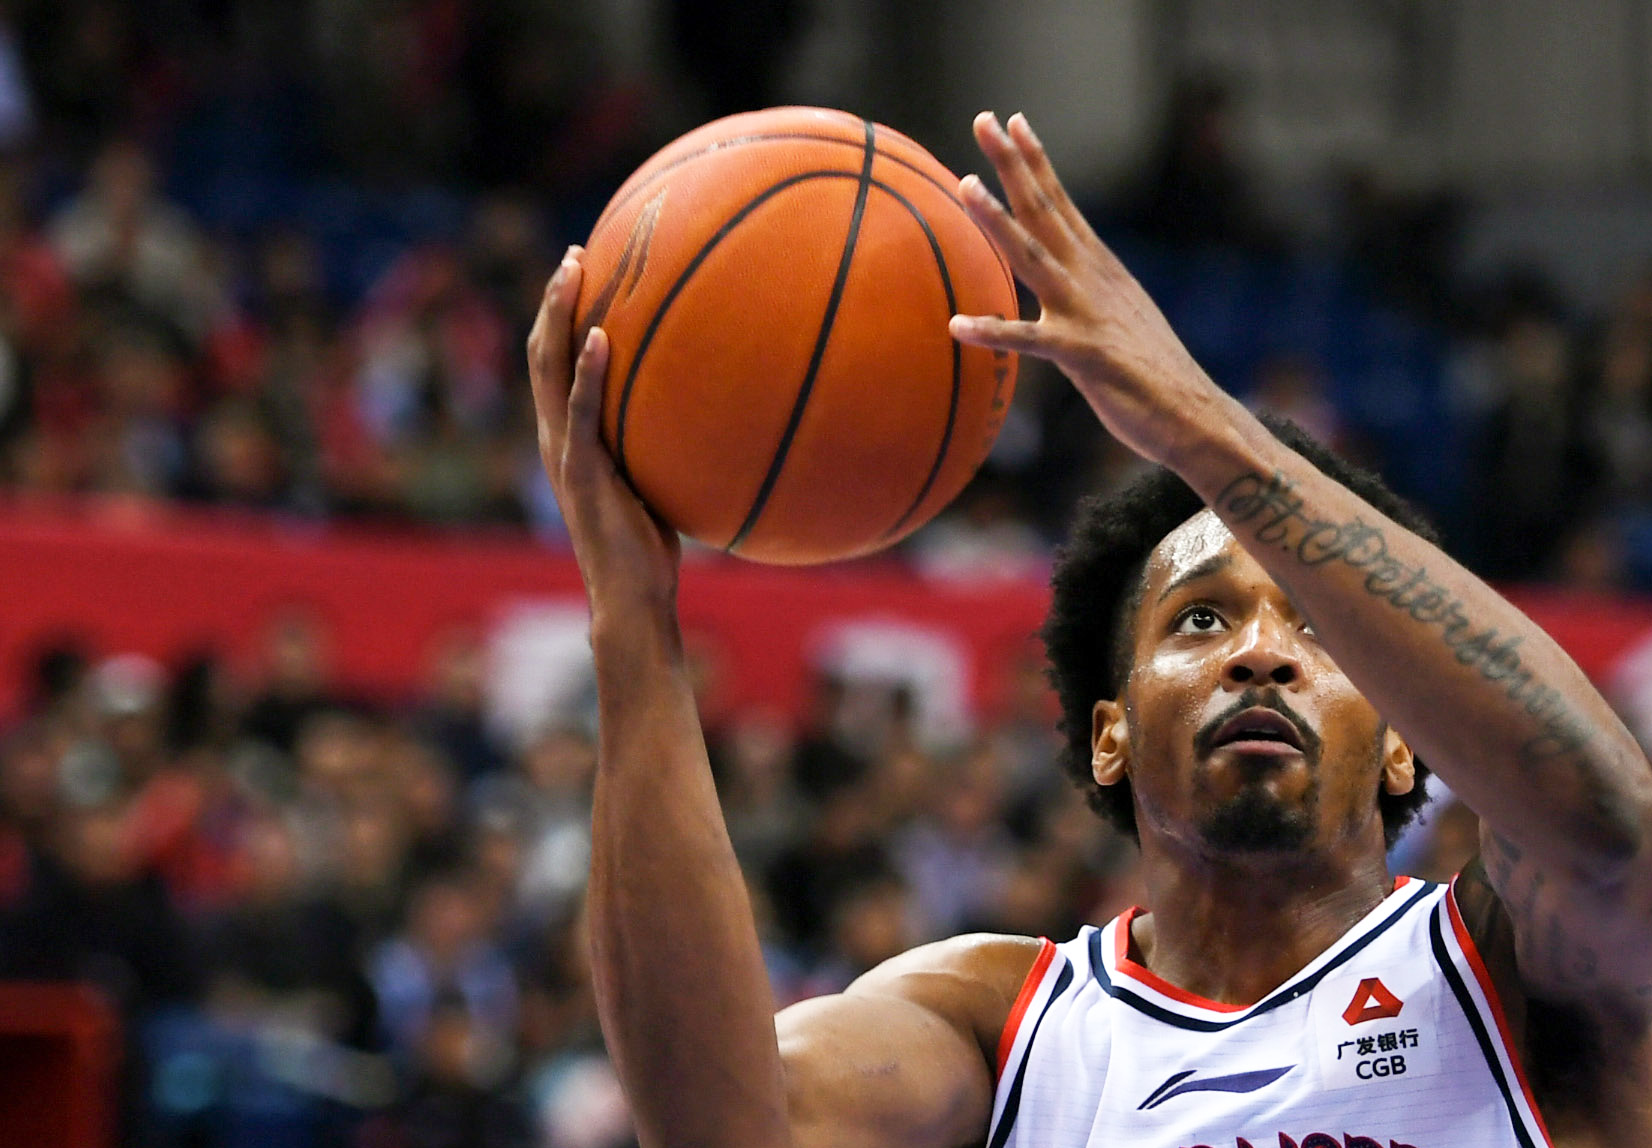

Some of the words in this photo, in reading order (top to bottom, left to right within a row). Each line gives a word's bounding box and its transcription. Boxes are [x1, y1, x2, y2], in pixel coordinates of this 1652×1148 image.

[1337, 1028, 1419, 1060] 广发银行
[1356, 1055, 1407, 1080] CGB
